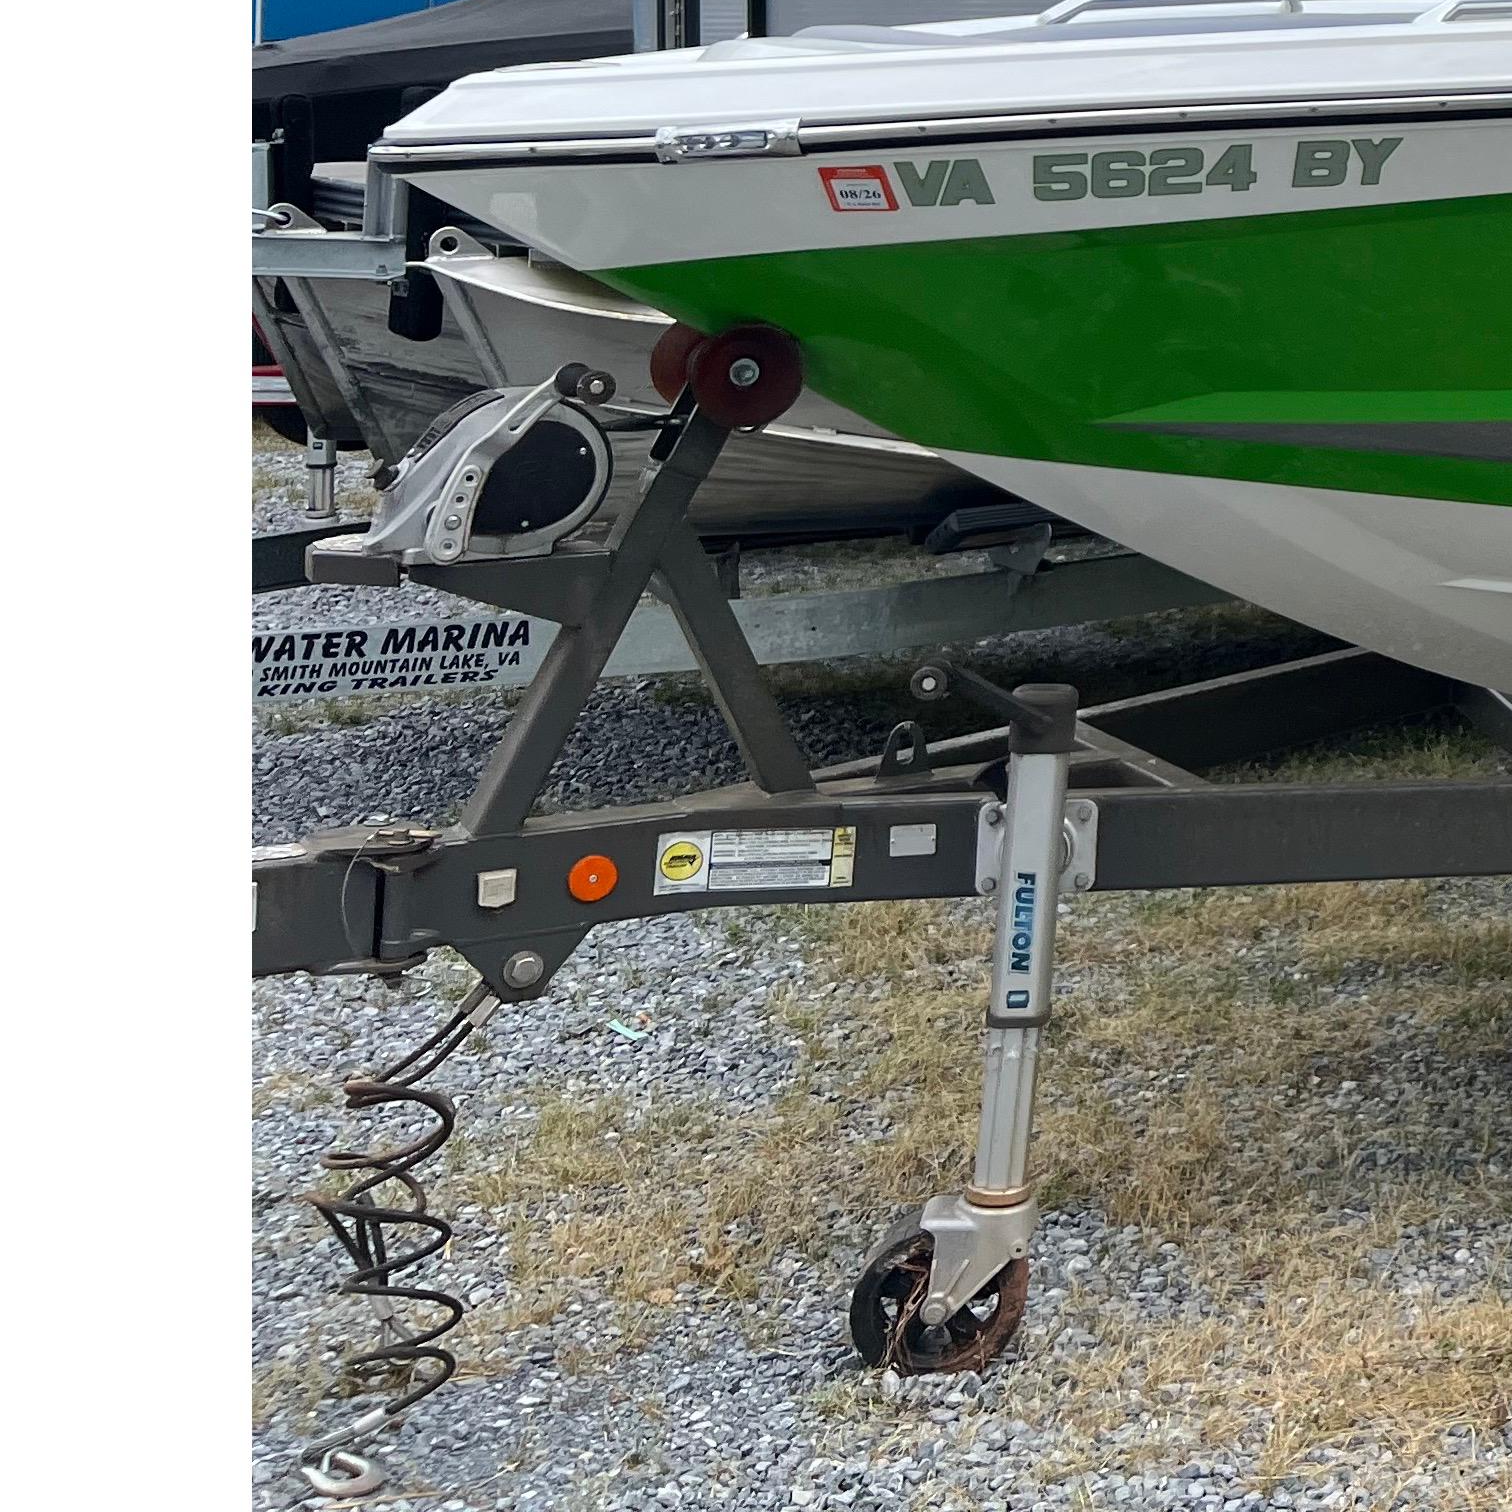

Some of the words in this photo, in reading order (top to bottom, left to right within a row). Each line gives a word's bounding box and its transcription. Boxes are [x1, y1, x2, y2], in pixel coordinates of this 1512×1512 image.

[894, 159, 995, 206] VA
[1033, 144, 1257, 201] 5624
[1292, 137, 1403, 187] BY
[380, 620, 530, 655] MARINA
[257, 681, 338, 697] KING
[352, 669, 498, 690] TRAILERS
[260, 663, 323, 682] SMITH
[329, 657, 433, 677] MOUNTAIN
[439, 653, 489, 670] LAKE,
[498, 651, 520, 666] VA
[1011, 872, 1035, 971] FULTON
